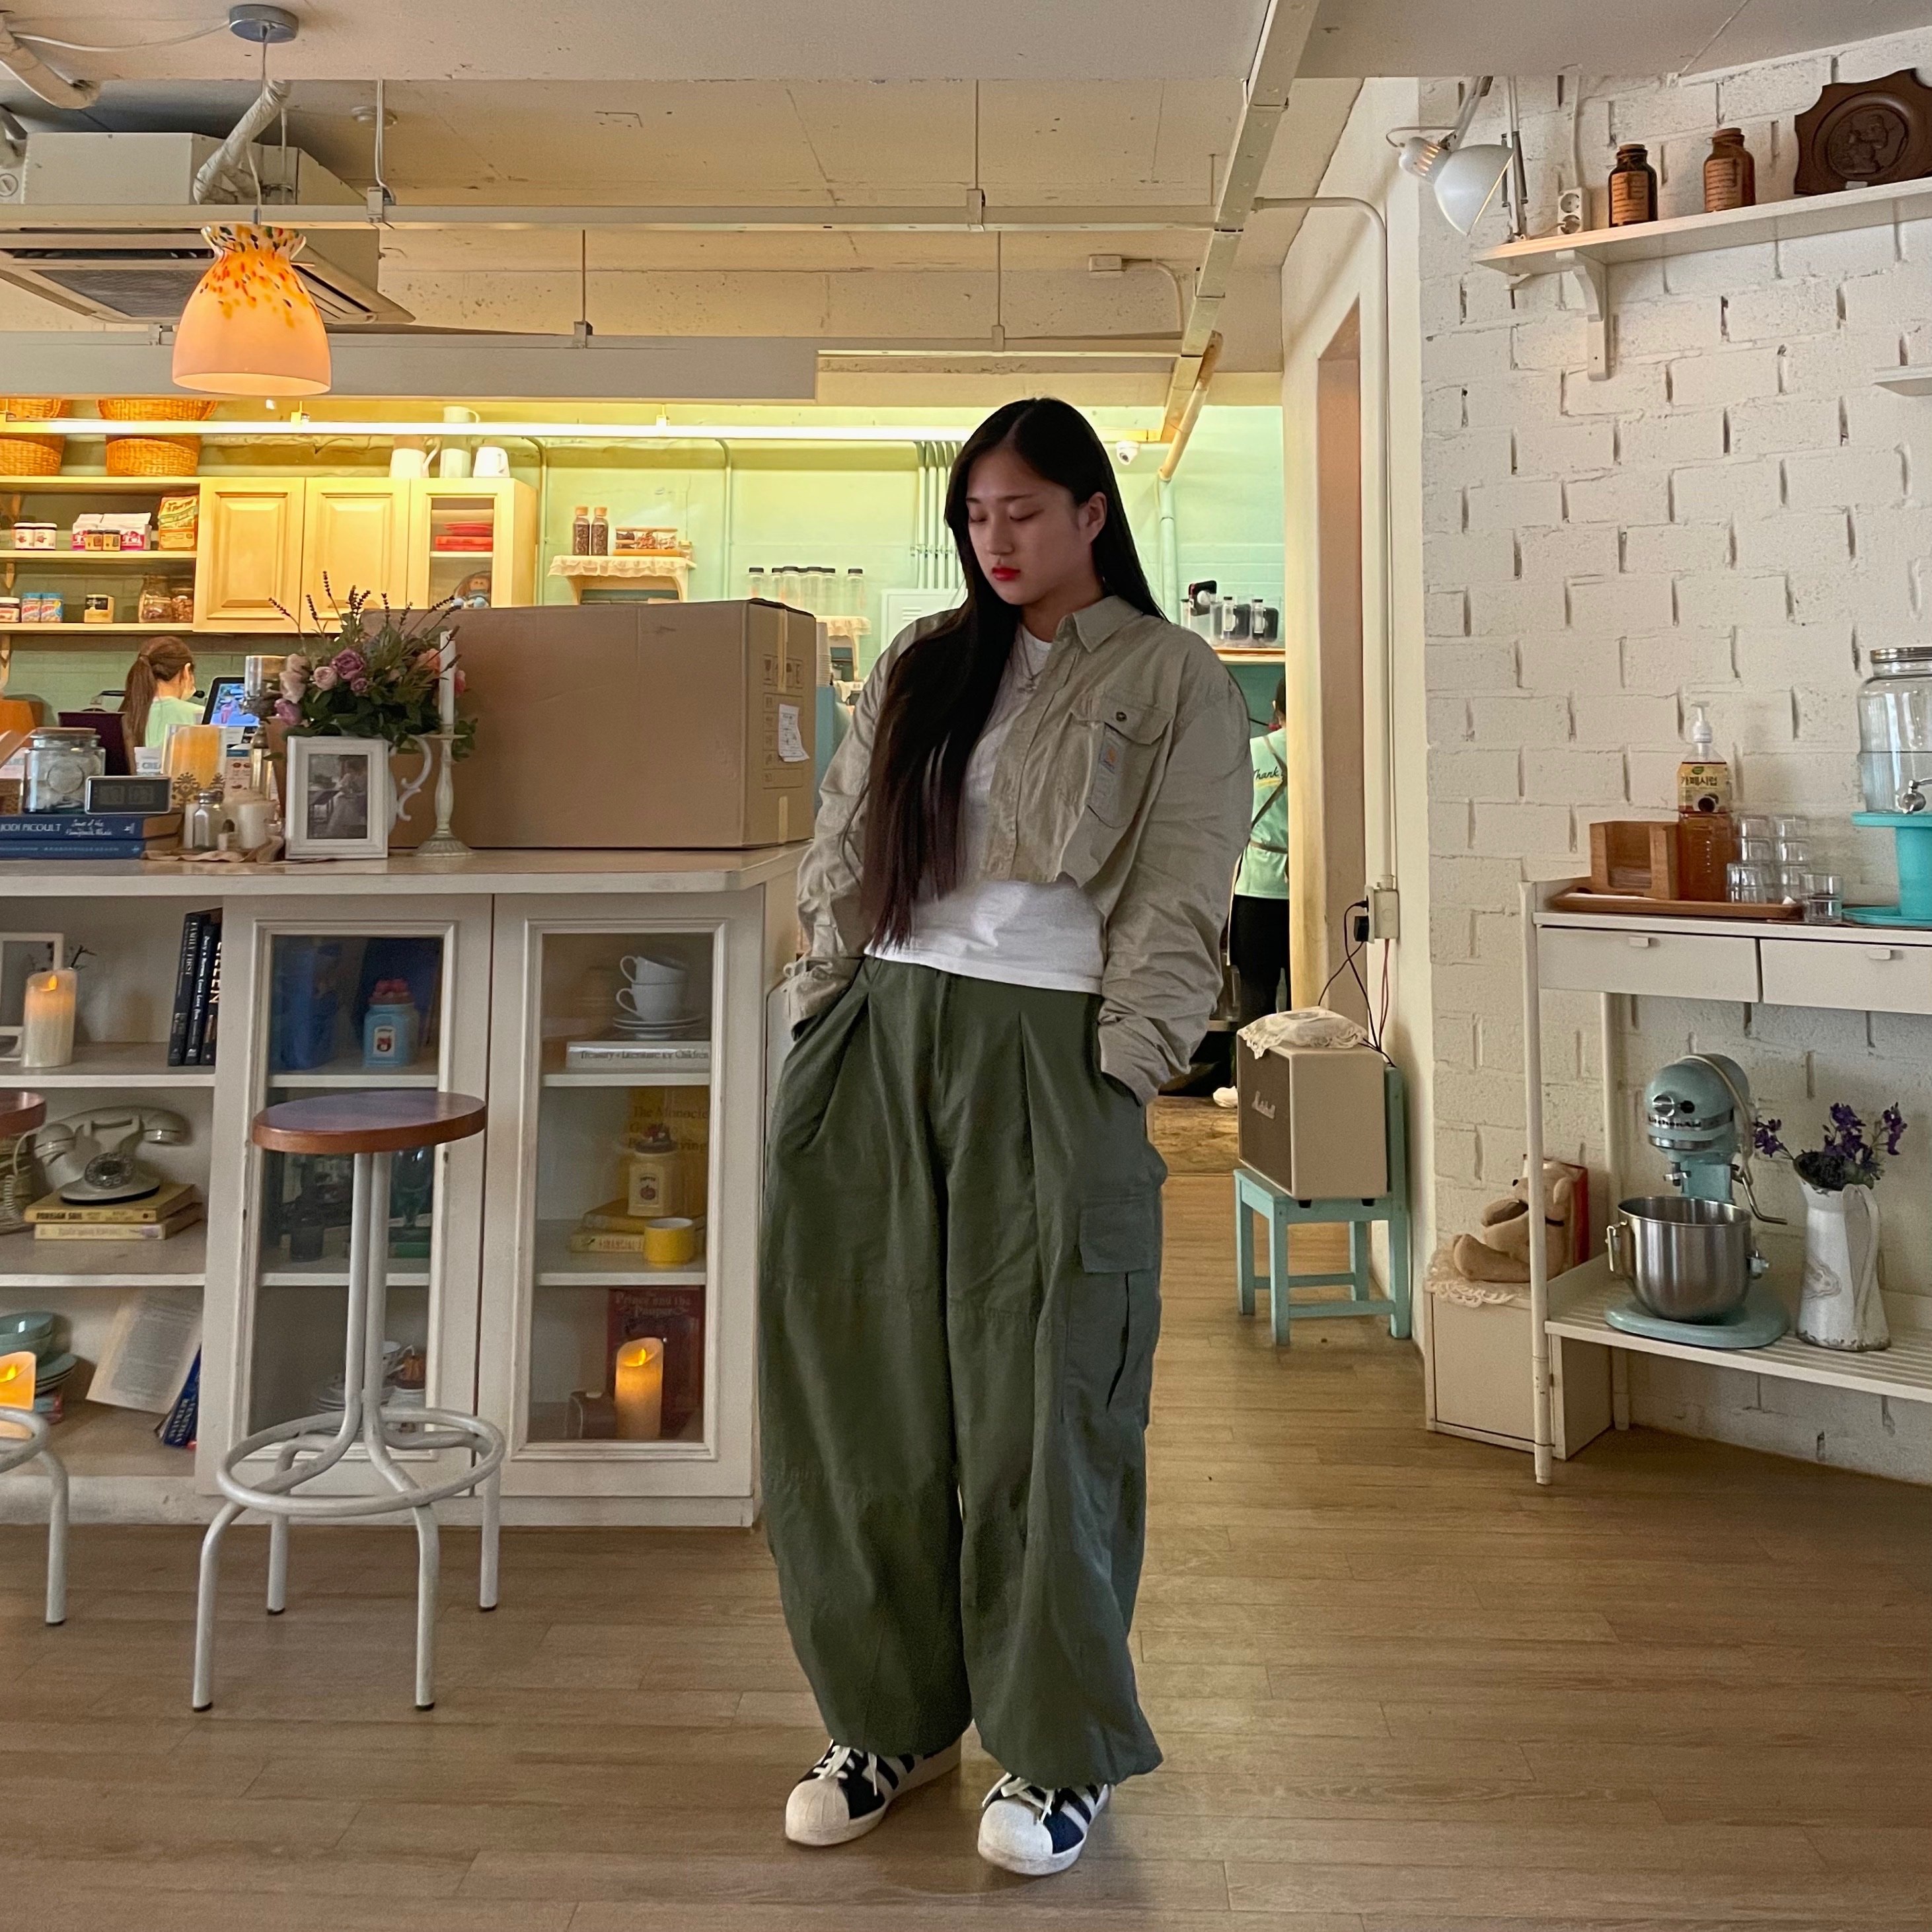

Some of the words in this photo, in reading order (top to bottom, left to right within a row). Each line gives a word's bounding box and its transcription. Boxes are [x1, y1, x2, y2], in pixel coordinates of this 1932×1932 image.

[1680, 776, 1718, 787] 카페시럽
[1, 823, 21, 833] JODI
[22, 823, 62, 833] PICOULT
[188, 922, 198, 950] FAMILY
[185, 953, 195, 975] FIRST
[675, 1049, 709, 1059] Children
[633, 1106, 652, 1118] The
